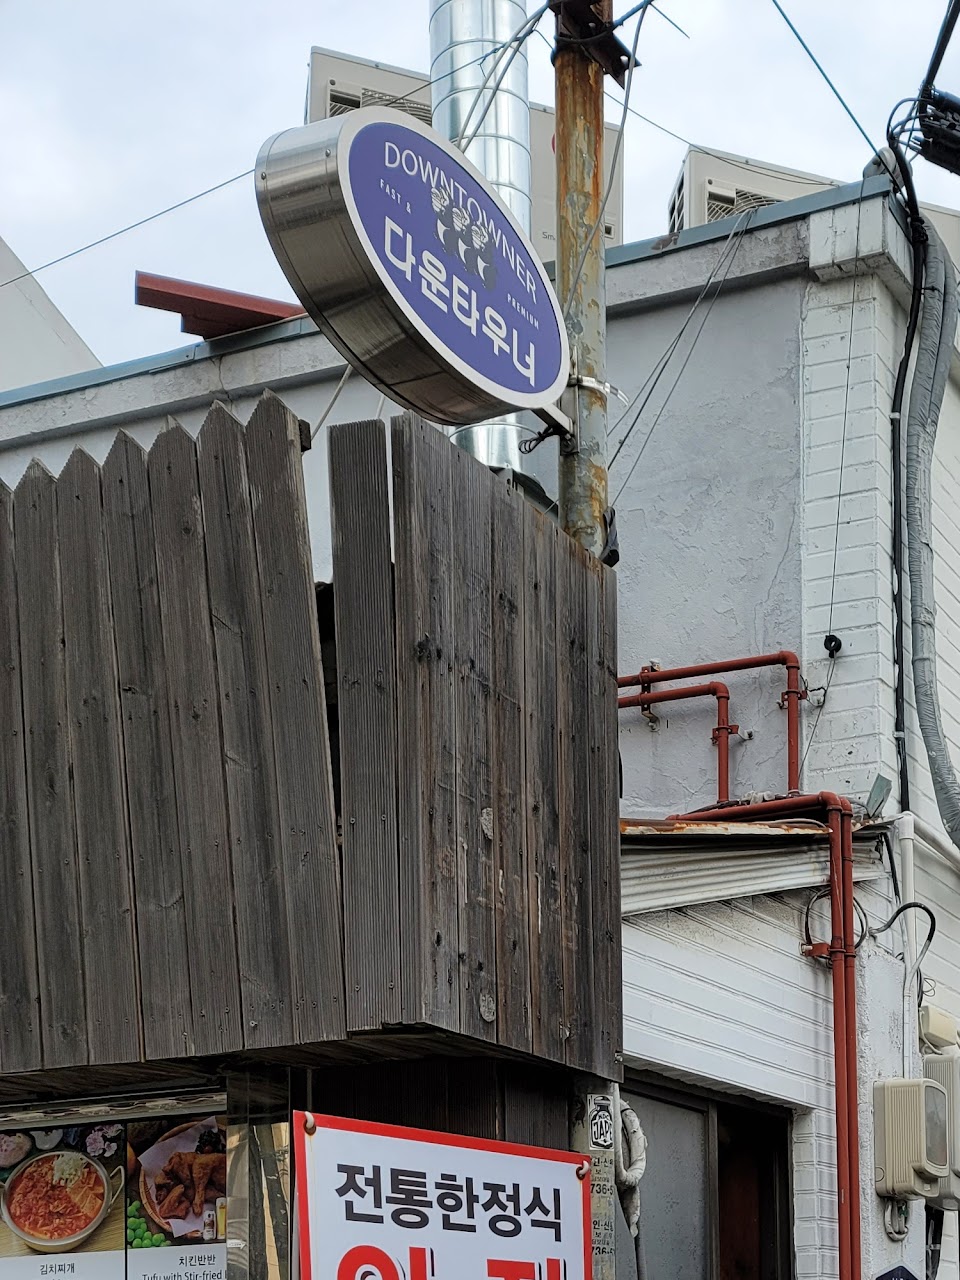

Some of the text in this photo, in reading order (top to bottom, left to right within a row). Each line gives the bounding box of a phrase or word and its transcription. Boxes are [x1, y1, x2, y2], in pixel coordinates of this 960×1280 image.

[380, 178, 401, 204] FAST
[385, 141, 536, 305] DOWNTOWNER
[385, 215, 535, 388] 다운타우너
[507, 293, 539, 330] PREMIUM
[335, 1163, 562, 1243] 전통한정식
[40, 1262, 75, 1276] 김치찌개
[178, 1254, 216, 1267] 치킨반반
